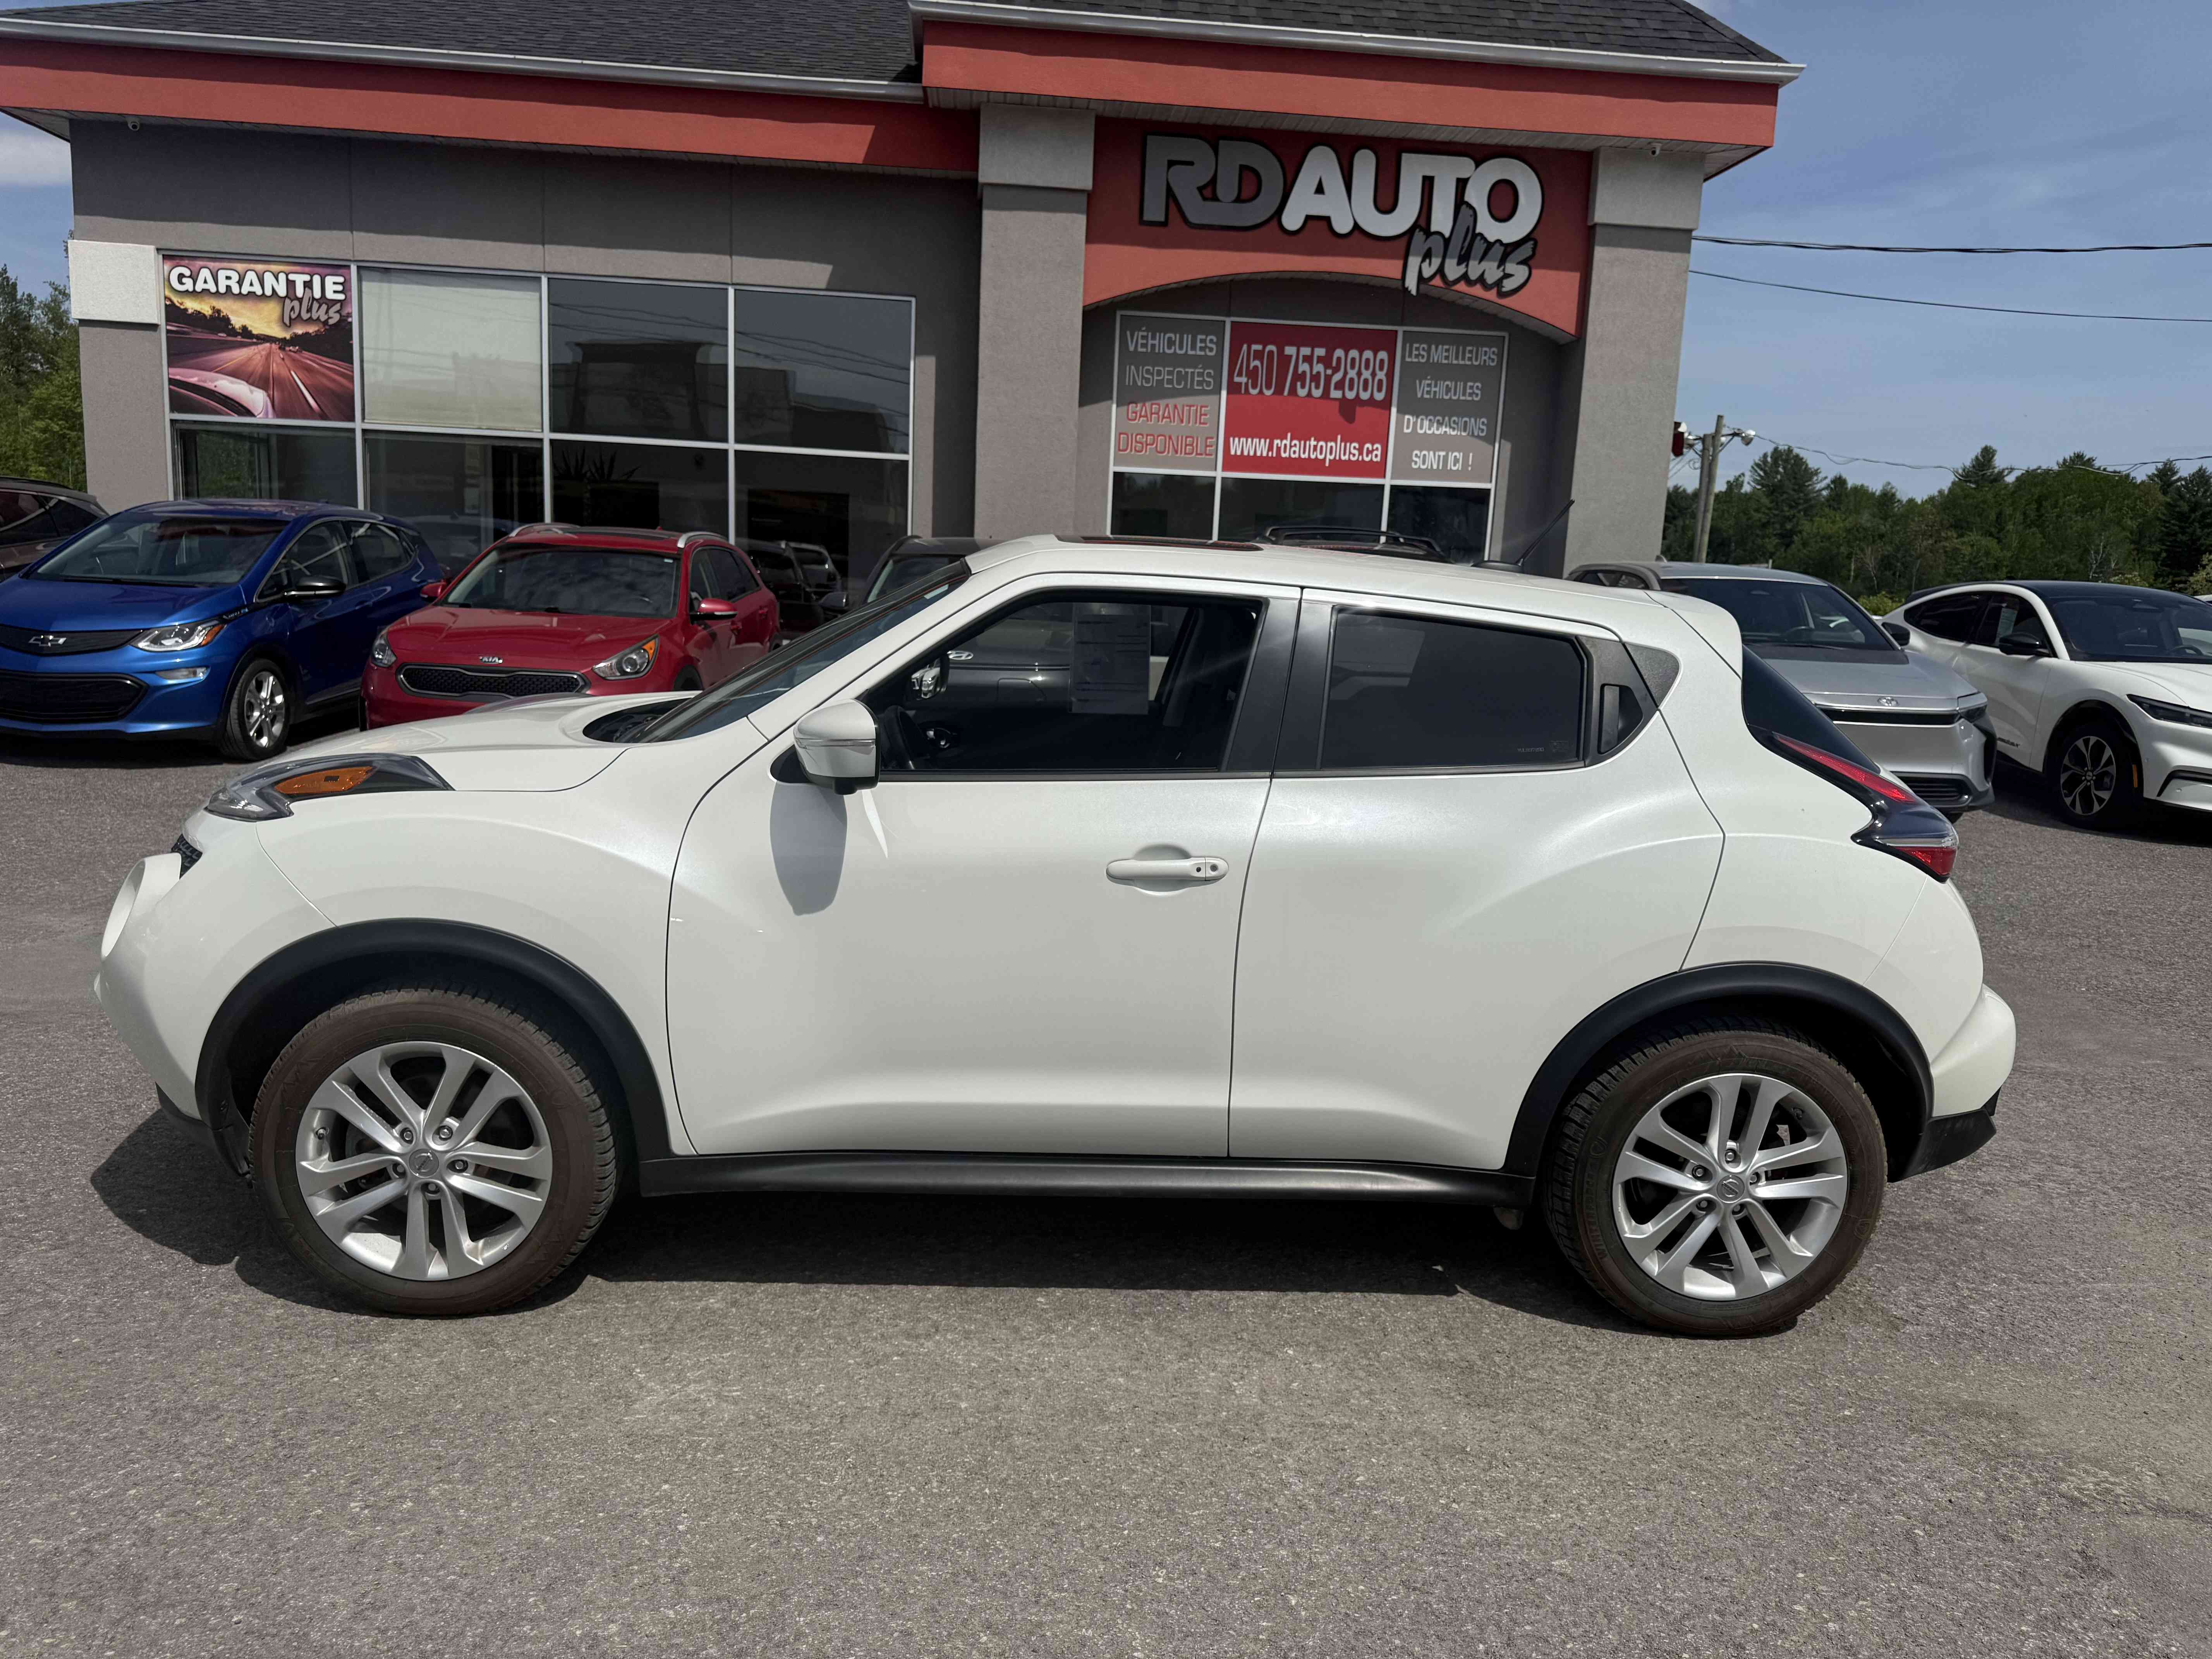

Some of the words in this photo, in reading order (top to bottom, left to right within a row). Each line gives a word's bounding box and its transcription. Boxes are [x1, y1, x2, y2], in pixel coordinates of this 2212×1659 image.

[1402, 201, 1536, 296] plus
[169, 266, 346, 301] GARANTIE
[283, 287, 342, 327] plus
[1126, 327, 1217, 356] VÉHICULES
[1405, 343, 1427, 362] LES
[1430, 344, 1498, 366] MEILLEURS
[1125, 364, 1214, 390] INSPECTÉS
[1233, 344, 1278, 396] 450
[1283, 346, 1389, 401] 755-2888
[1416, 376, 1482, 400] VÉHICULES
[1127, 402, 1210, 426] GARANTIE
[1403, 415, 1487, 436] D'OCCASIONS
[1117, 432, 1215, 458] DISPONIBLE
[1230, 433, 1382, 467] www.rdautoplus.ca
[1412, 450, 1446, 470] SONT
[1447, 452, 1463, 471] ICI
